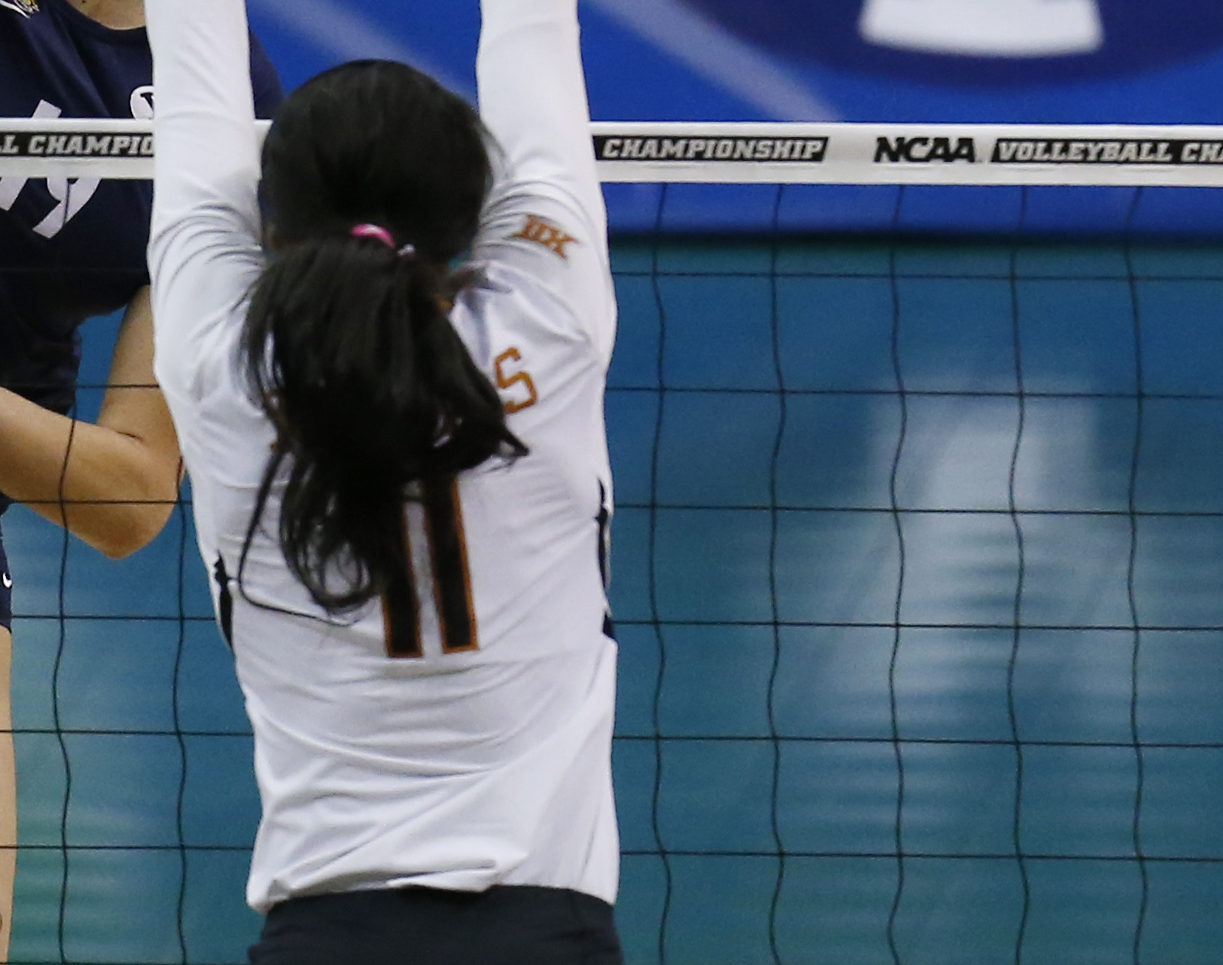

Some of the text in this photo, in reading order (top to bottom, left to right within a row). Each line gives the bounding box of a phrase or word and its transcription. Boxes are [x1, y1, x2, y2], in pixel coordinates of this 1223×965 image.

[602, 138, 823, 159] CHAMPIONSHIP
[874, 137, 976, 163] NCAA
[998, 141, 1173, 162] VOLLEYBALL
[1181, 142, 1223, 162] CH
